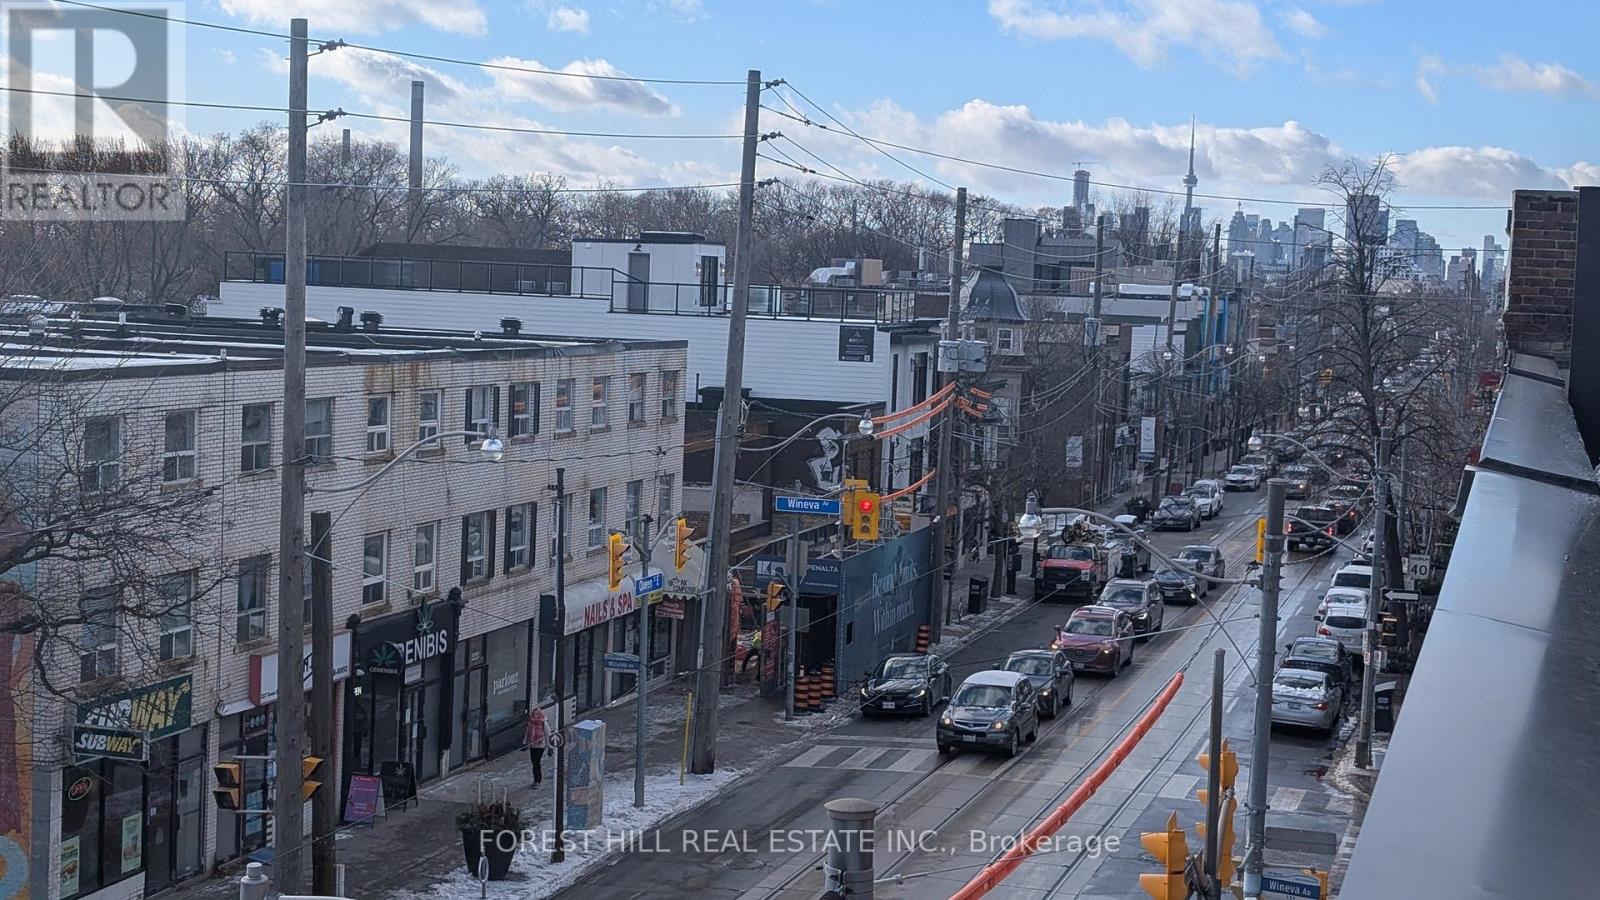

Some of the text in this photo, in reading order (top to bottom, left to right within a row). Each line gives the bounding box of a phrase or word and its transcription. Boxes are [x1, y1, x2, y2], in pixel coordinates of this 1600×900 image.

[787, 498, 820, 510] Wineva
[807, 564, 839, 573] PENALTA
[1411, 564, 1427, 575] 40
[638, 579, 653, 592] Queen
[584, 600, 608, 628] NAILS
[609, 597, 616, 617] &
[617, 591, 633, 615] SPA
[76, 733, 142, 754] SUBWAY
[1269, 880, 1300, 894] Wineva
